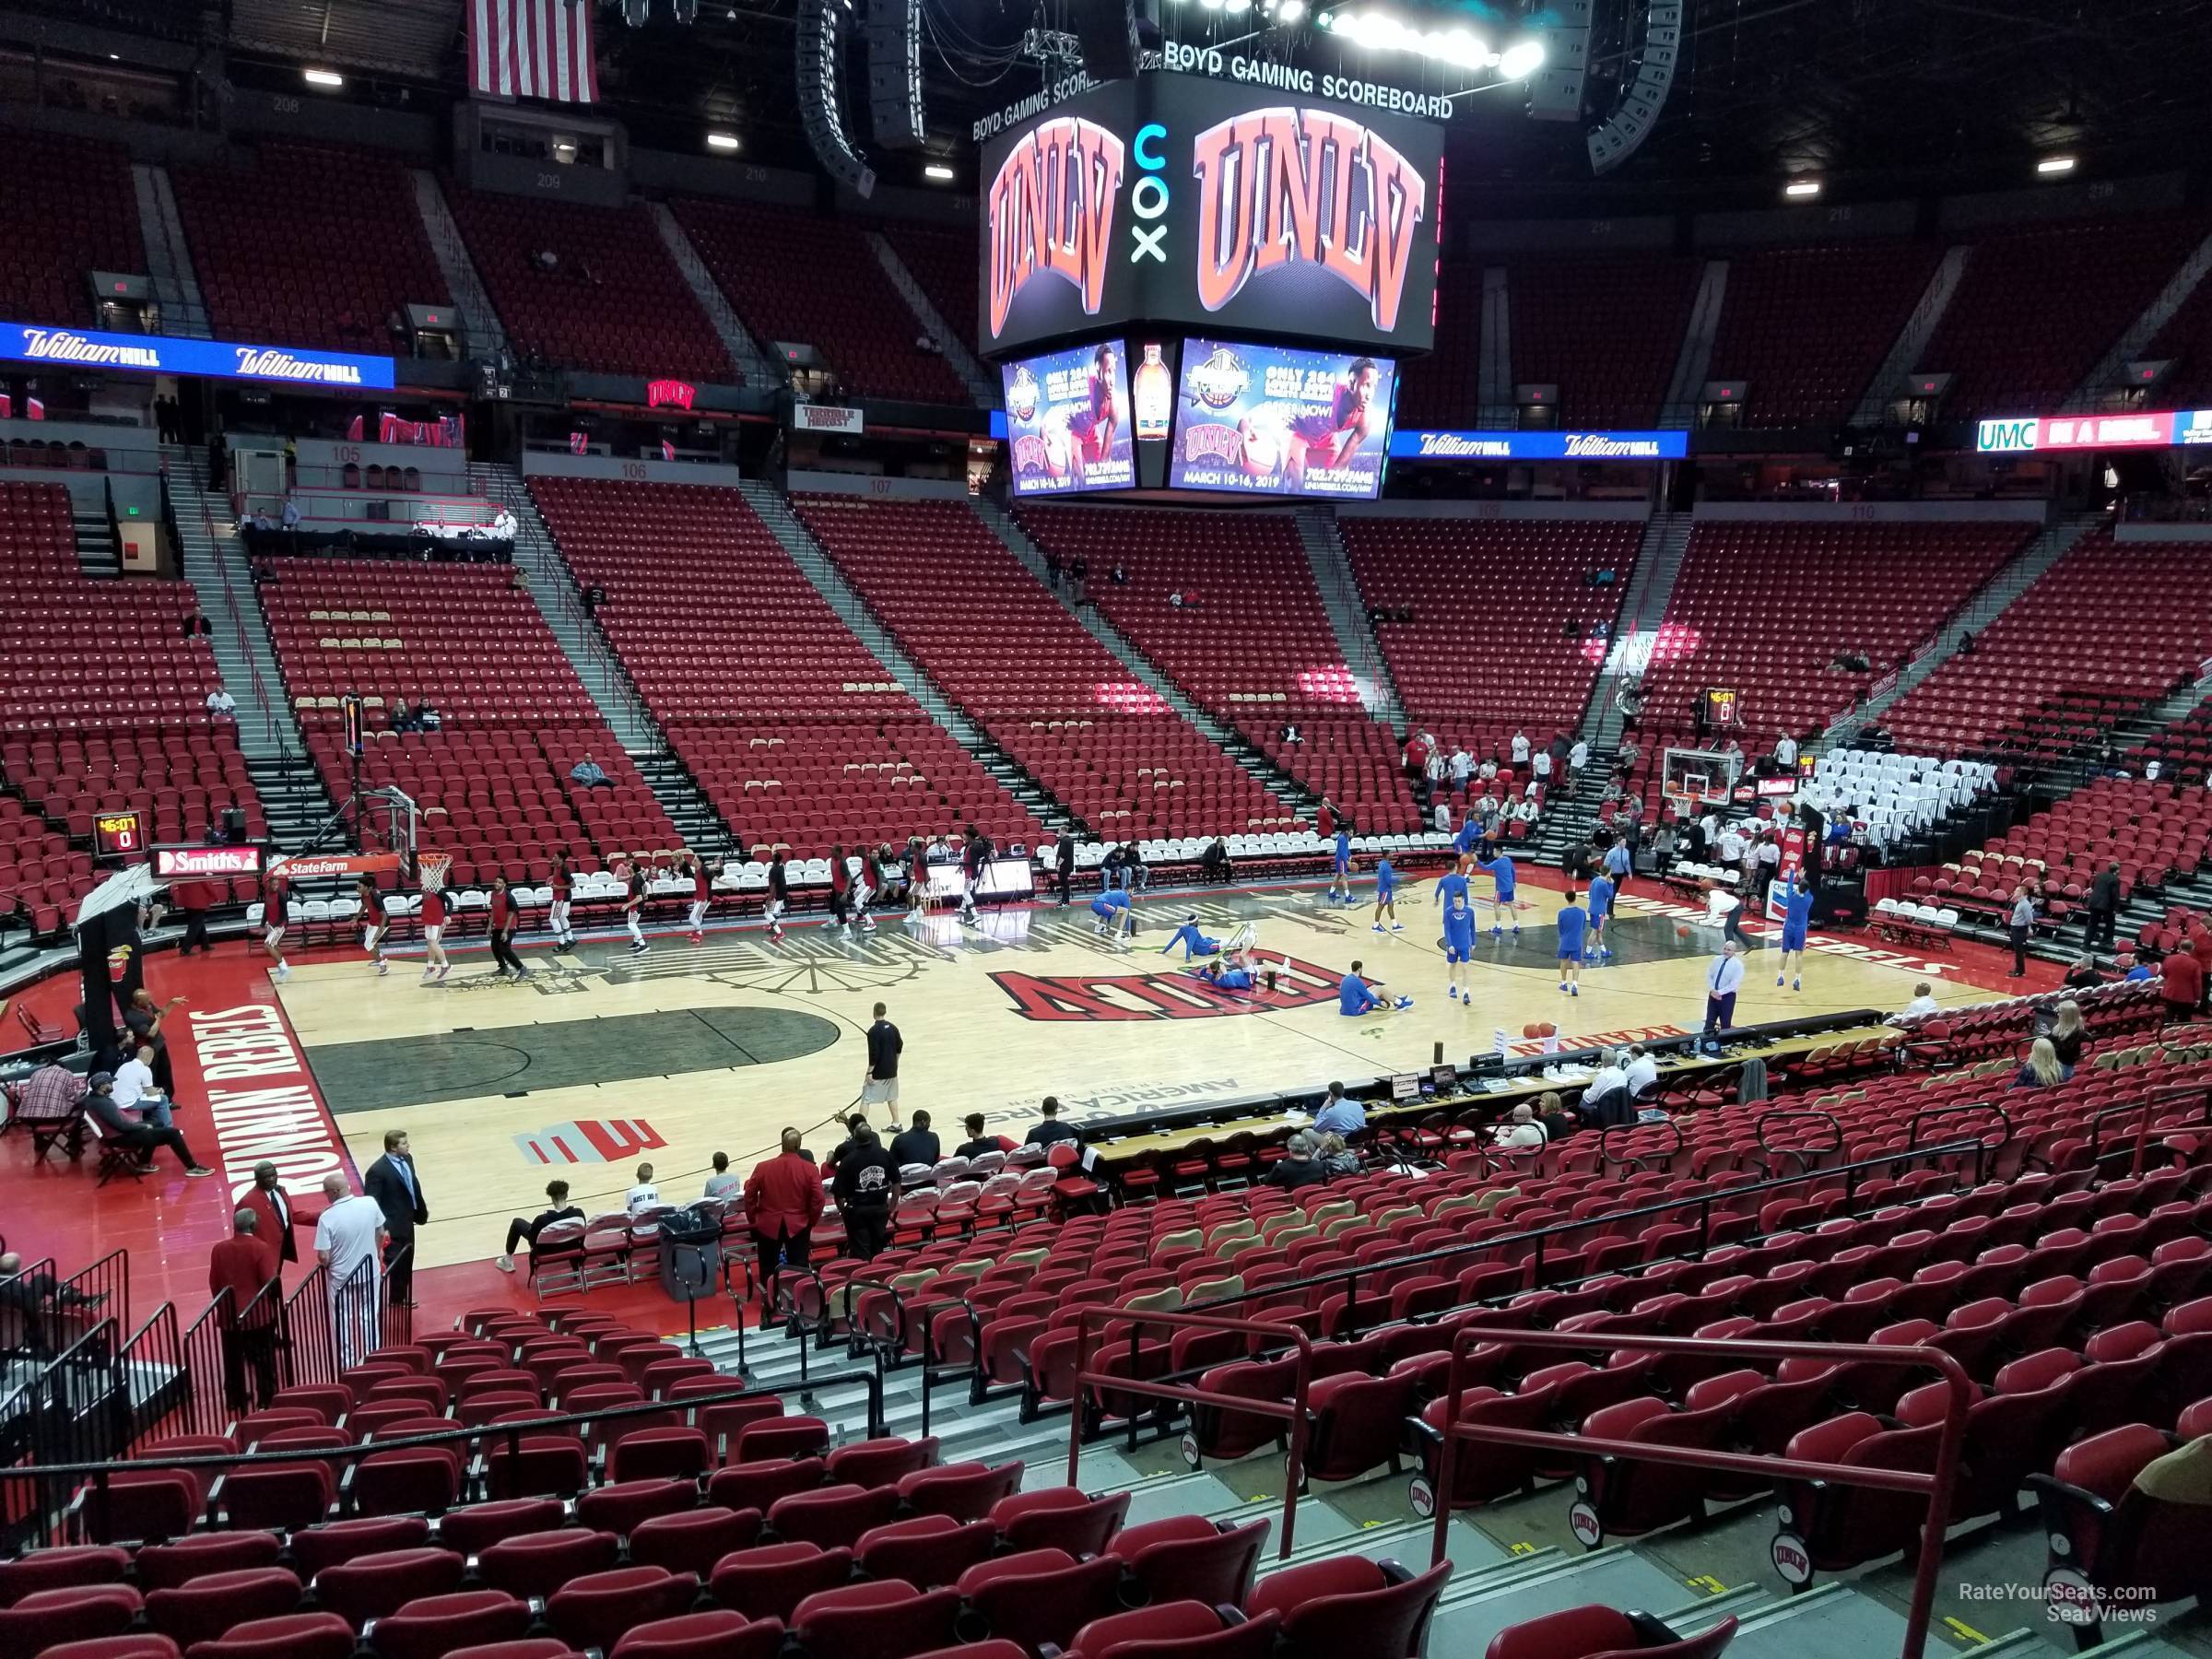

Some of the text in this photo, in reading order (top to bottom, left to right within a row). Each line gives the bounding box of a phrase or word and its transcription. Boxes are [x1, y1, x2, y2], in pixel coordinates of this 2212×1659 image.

[1163, 40, 1453, 119] BOYD GAMING SCOREBOARD
[972, 112, 1001, 141] BOYD
[1005, 88, 1049, 126] GAMING
[538, 172, 561, 189] 209
[746, 167, 767, 182] 210
[1130, 124, 1170, 264] COX
[989, 117, 1125, 339] UNLV
[1194, 107, 1426, 333] UNLV
[23, 328, 160, 367] William HILL
[236, 347, 361, 383] William HILL
[1265, 365, 1304, 382] ONLY
[647, 380, 695, 411] UNLV
[1185, 423, 1243, 464] UNLV
[1419, 433, 1511, 456] William HILL
[1564, 434, 1660, 456] William HILL
[1979, 422, 2036, 450] UMC
[333, 445, 361, 463] 105
[622, 463, 647, 478] 106
[1183, 471, 1280, 488] MARCH 10-16, 2019
[871, 479, 892, 494] 107
[1853, 505, 1876, 519] 110
[1710, 691, 1734, 703] 46:07
[1721, 702, 1731, 722] 0
[99, 817, 135, 832] 46:07
[119, 831, 132, 848] 0
[175, 852, 242, 872] Smith's
[986, 947, 1384, 1022] UNLV
[189, 1005, 301, 1082] REBELS
[1074, 1077, 1240, 1108] AMERICA
[1574, 1512, 1599, 1538] UNLV
[1776, 1545, 1807, 1576] UNLV
